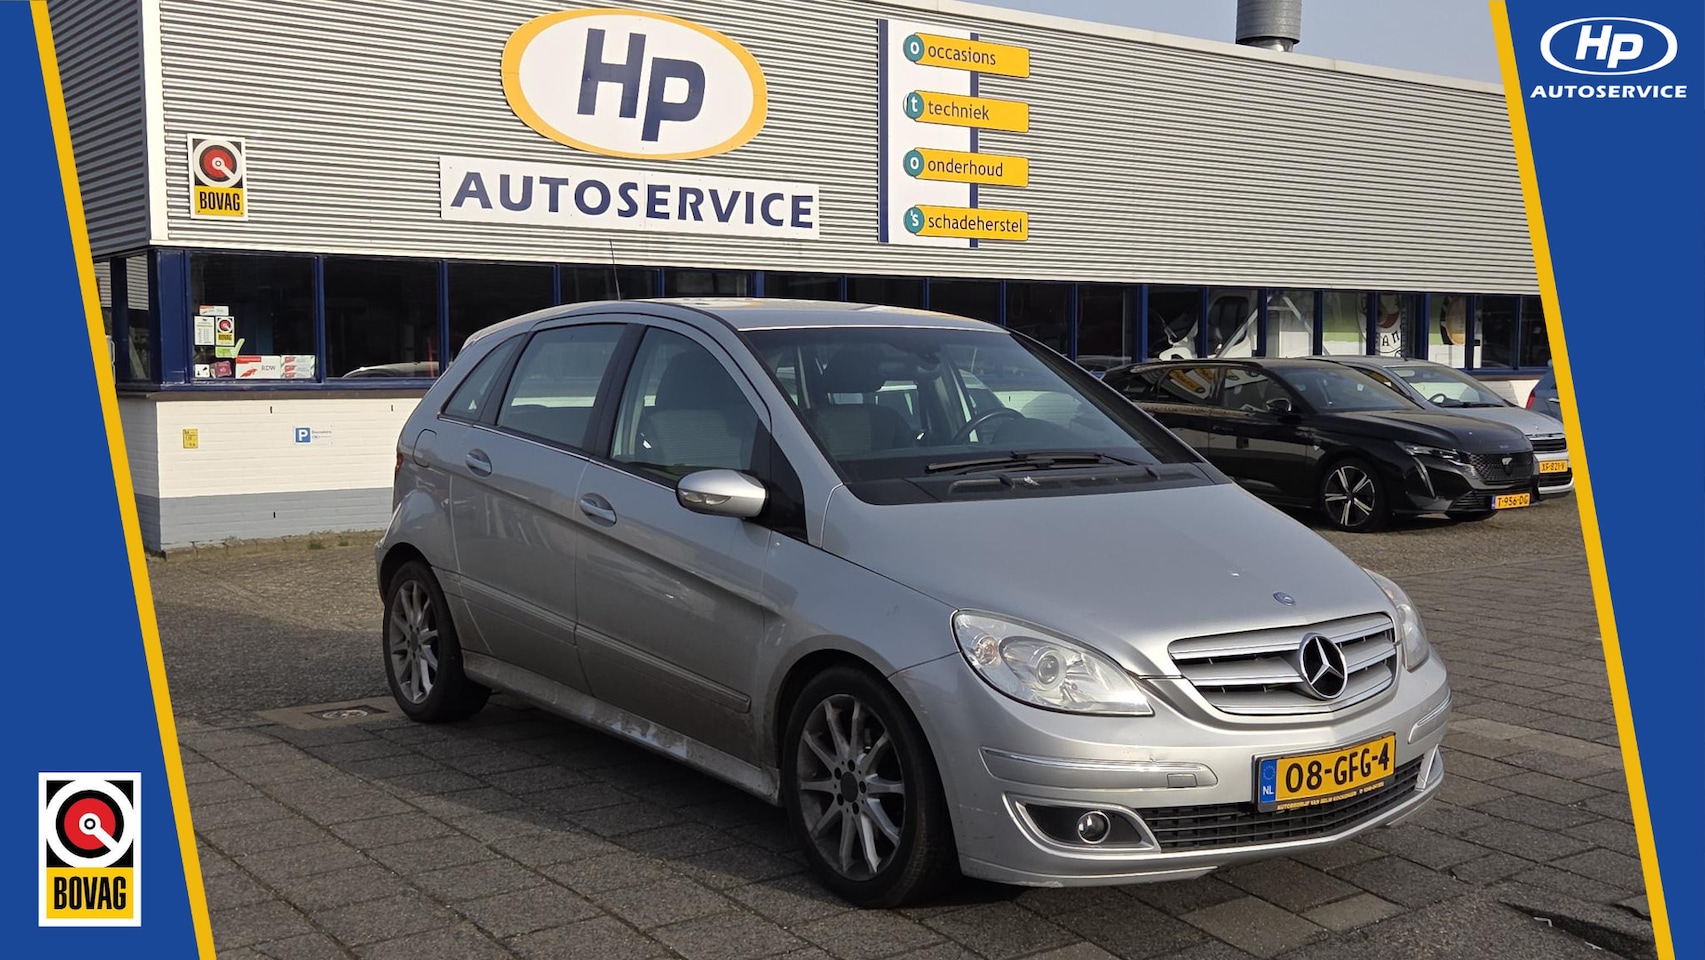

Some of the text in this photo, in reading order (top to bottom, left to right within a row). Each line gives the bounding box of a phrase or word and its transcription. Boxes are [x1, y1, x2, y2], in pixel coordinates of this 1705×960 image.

[928, 45, 996, 65] occasions
[928, 101, 990, 120] techniek
[928, 158, 1003, 177] onderhoud
[200, 191, 240, 211] BOVAG
[450, 171, 814, 228] AUTOSERVICE
[928, 214, 1023, 232] schadeherstel
[1285, 742, 1390, 793] 08-GFG-4
[1262, 785, 1275, 796] NL
